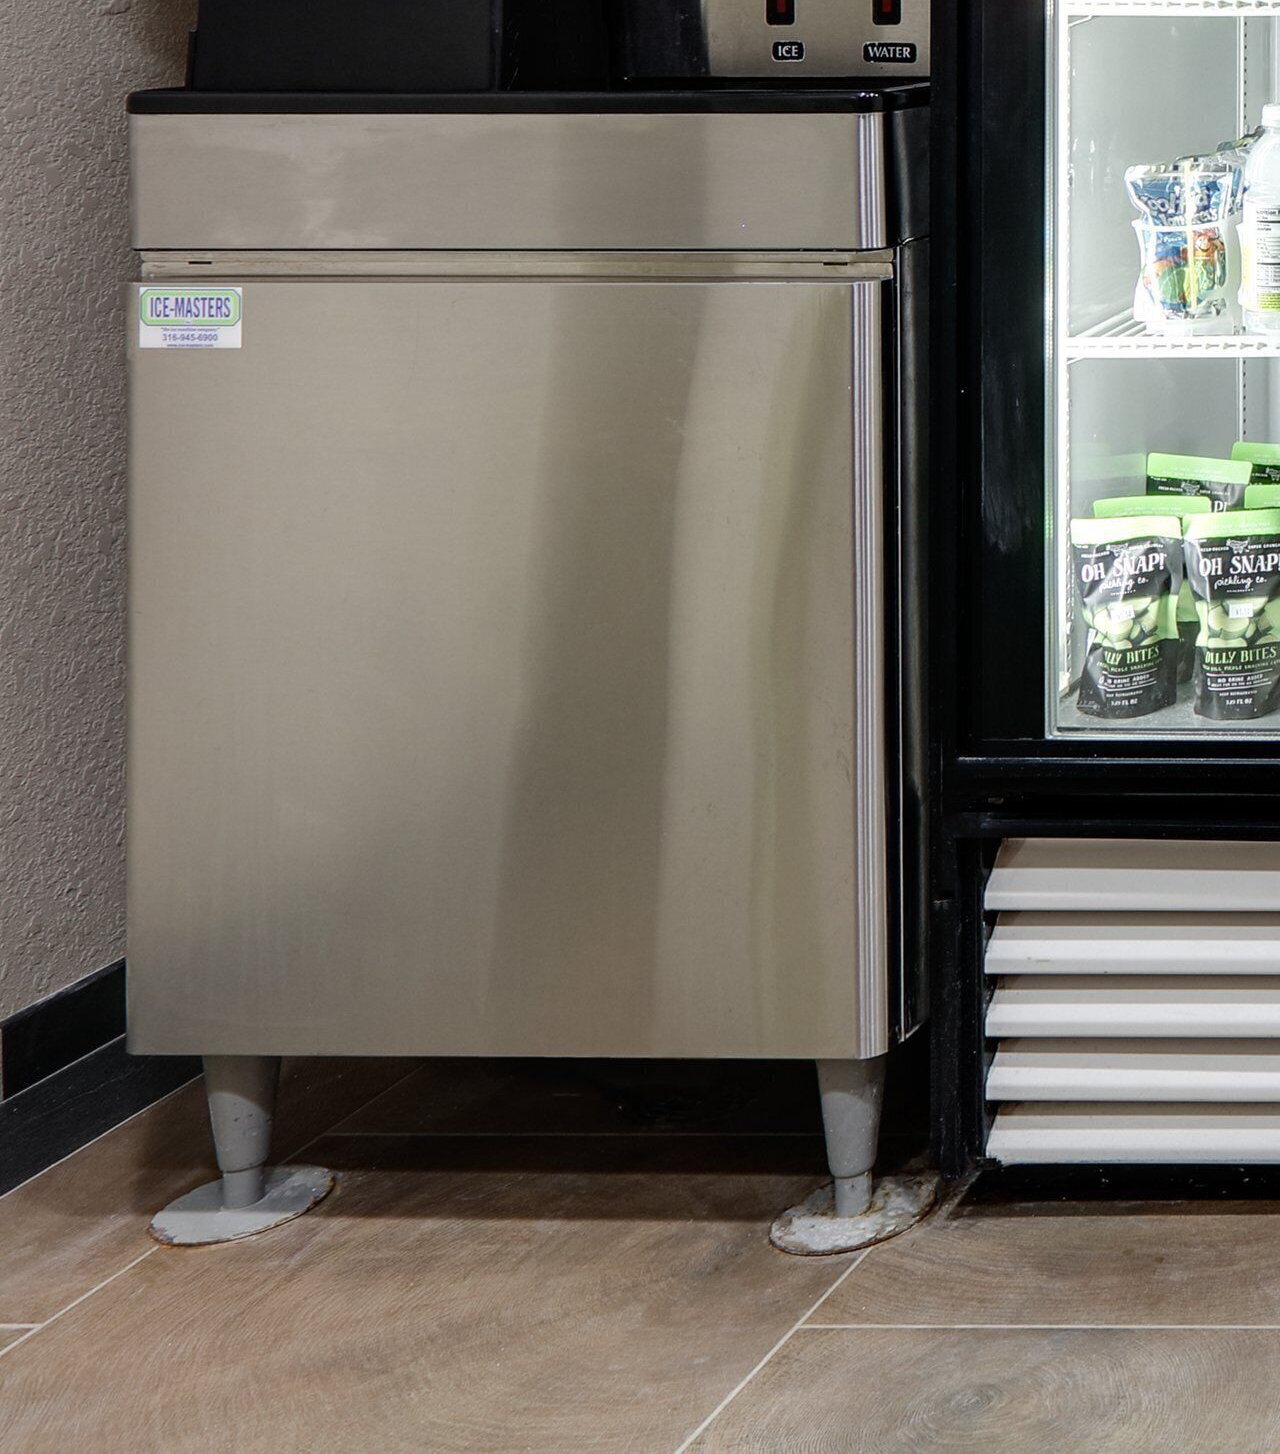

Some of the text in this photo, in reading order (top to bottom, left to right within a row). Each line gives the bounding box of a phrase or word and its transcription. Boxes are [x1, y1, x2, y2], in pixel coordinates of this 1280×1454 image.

[777, 45, 799, 57] ICE
[868, 46, 911, 59] WATER
[150, 296, 231, 318] ICE-MASTERS
[1081, 552, 1165, 583] OH SNAP!
[1199, 557, 1223, 577] OH
[1214, 577, 1254, 590] pickling
[1126, 645, 1160, 663] BITES
[1240, 646, 1277, 663] BITES
